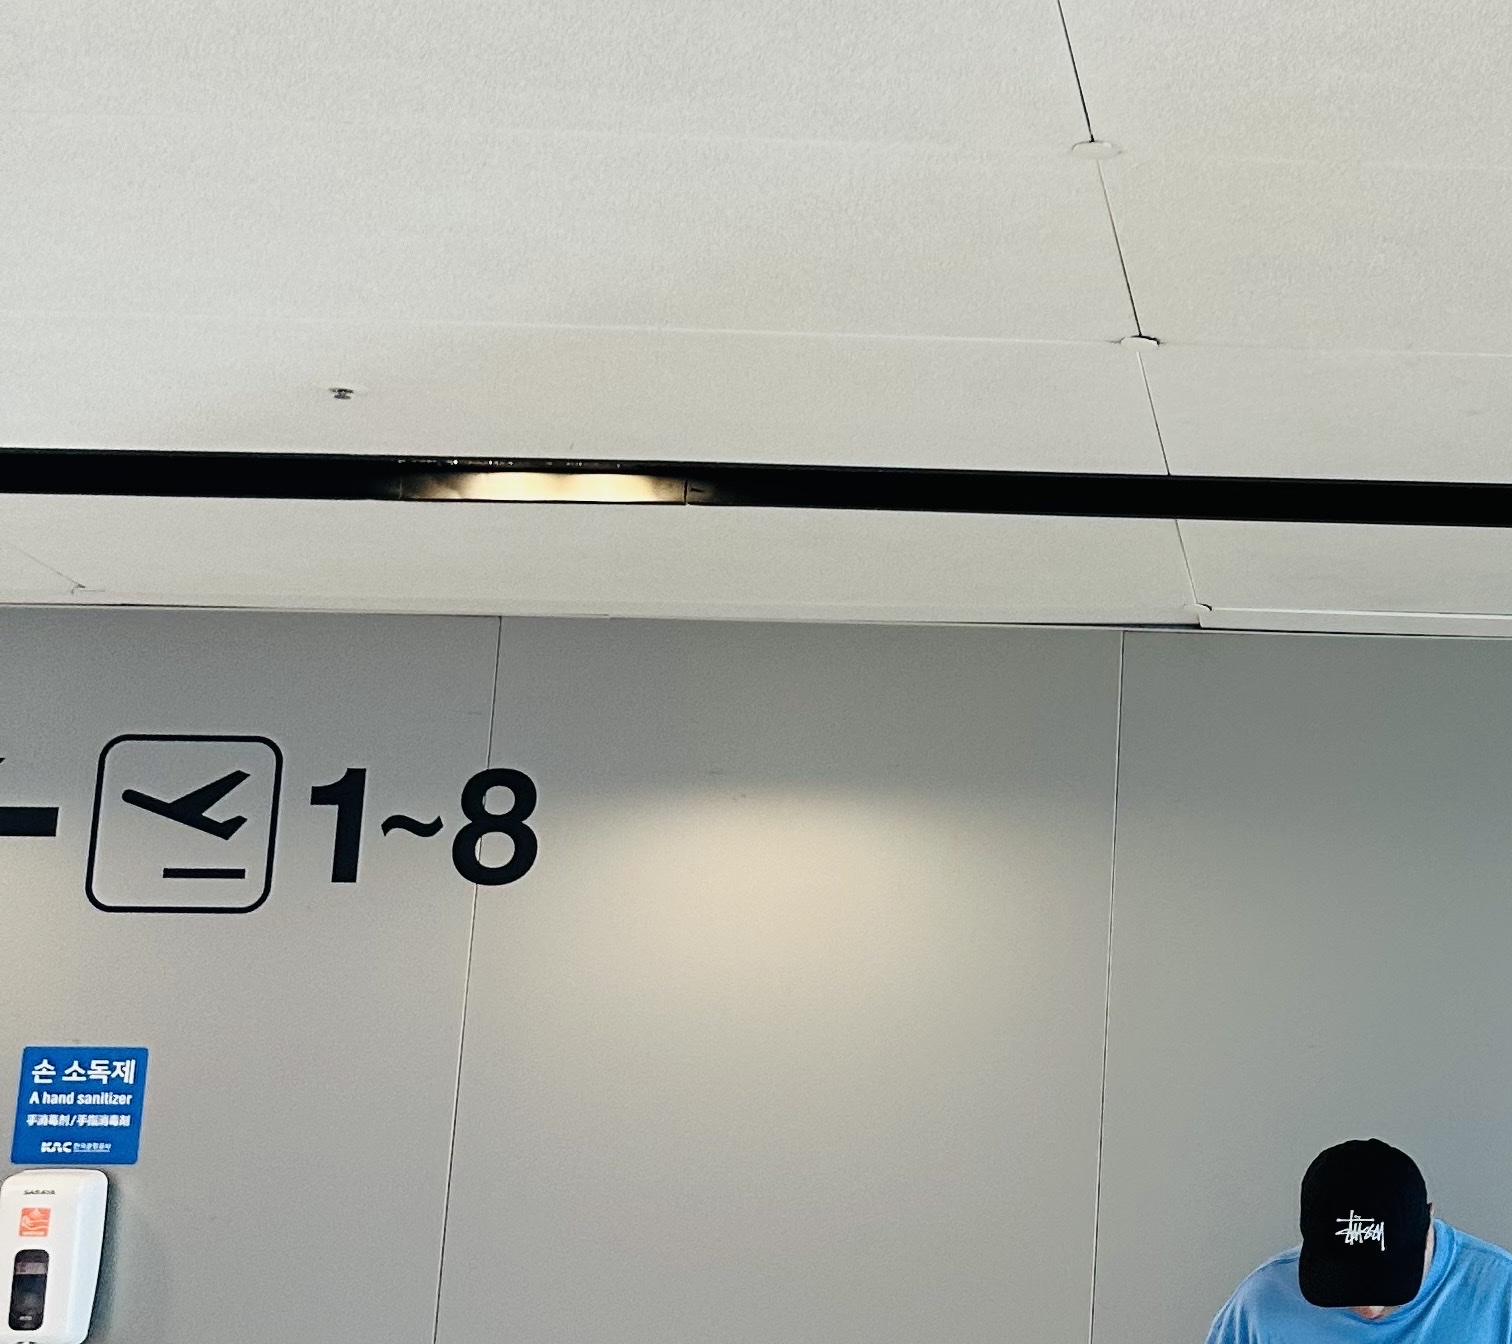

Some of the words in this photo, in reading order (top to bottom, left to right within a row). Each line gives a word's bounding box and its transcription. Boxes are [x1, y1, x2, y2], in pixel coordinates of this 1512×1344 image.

[310, 767, 538, 886] 1~8
[31, 1058, 57, 1084] 손
[61, 1058, 136, 1085] 소독제
[28, 1091, 40, 1105] A
[42, 1091, 75, 1105] hand
[76, 1092, 133, 1105] sanitizer
